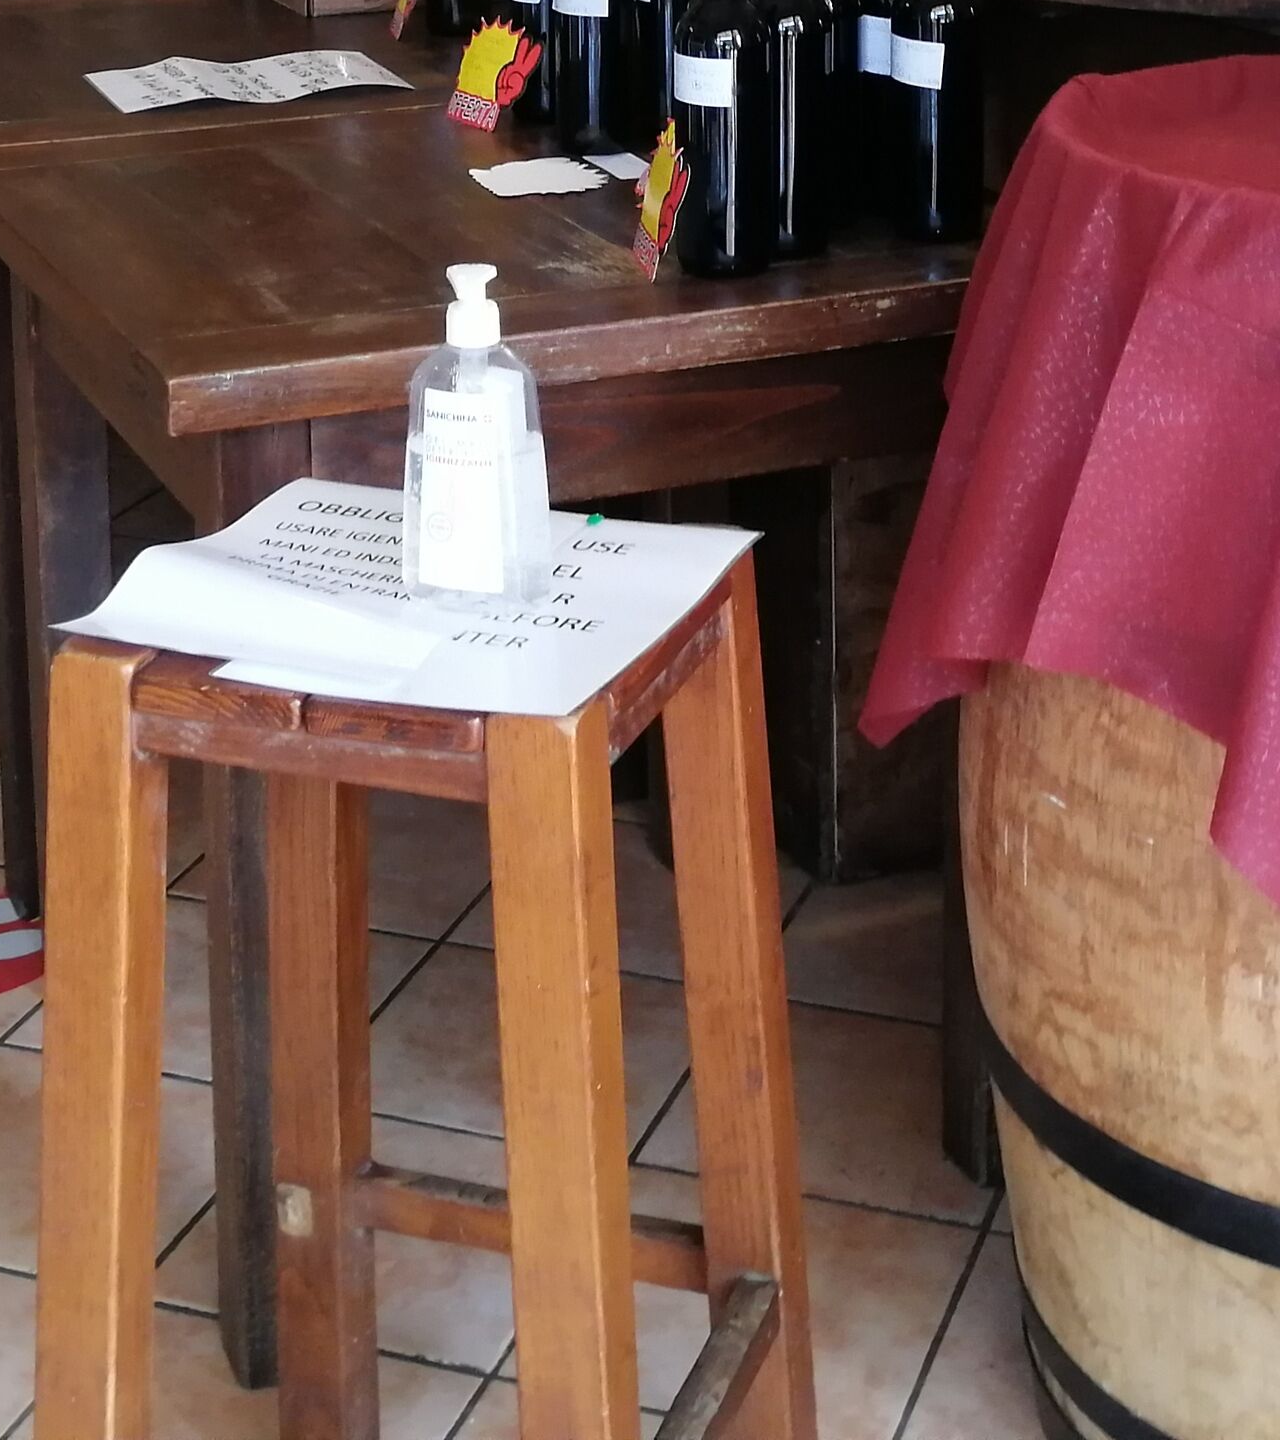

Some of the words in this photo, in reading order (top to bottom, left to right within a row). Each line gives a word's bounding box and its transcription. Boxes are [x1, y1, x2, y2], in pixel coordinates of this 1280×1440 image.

[275, 520, 343, 541] USARE
[258, 537, 320, 556] MANI
[571, 538, 637, 557] USE
[551, 562, 585, 581] EL
[551, 591, 576, 606] R
